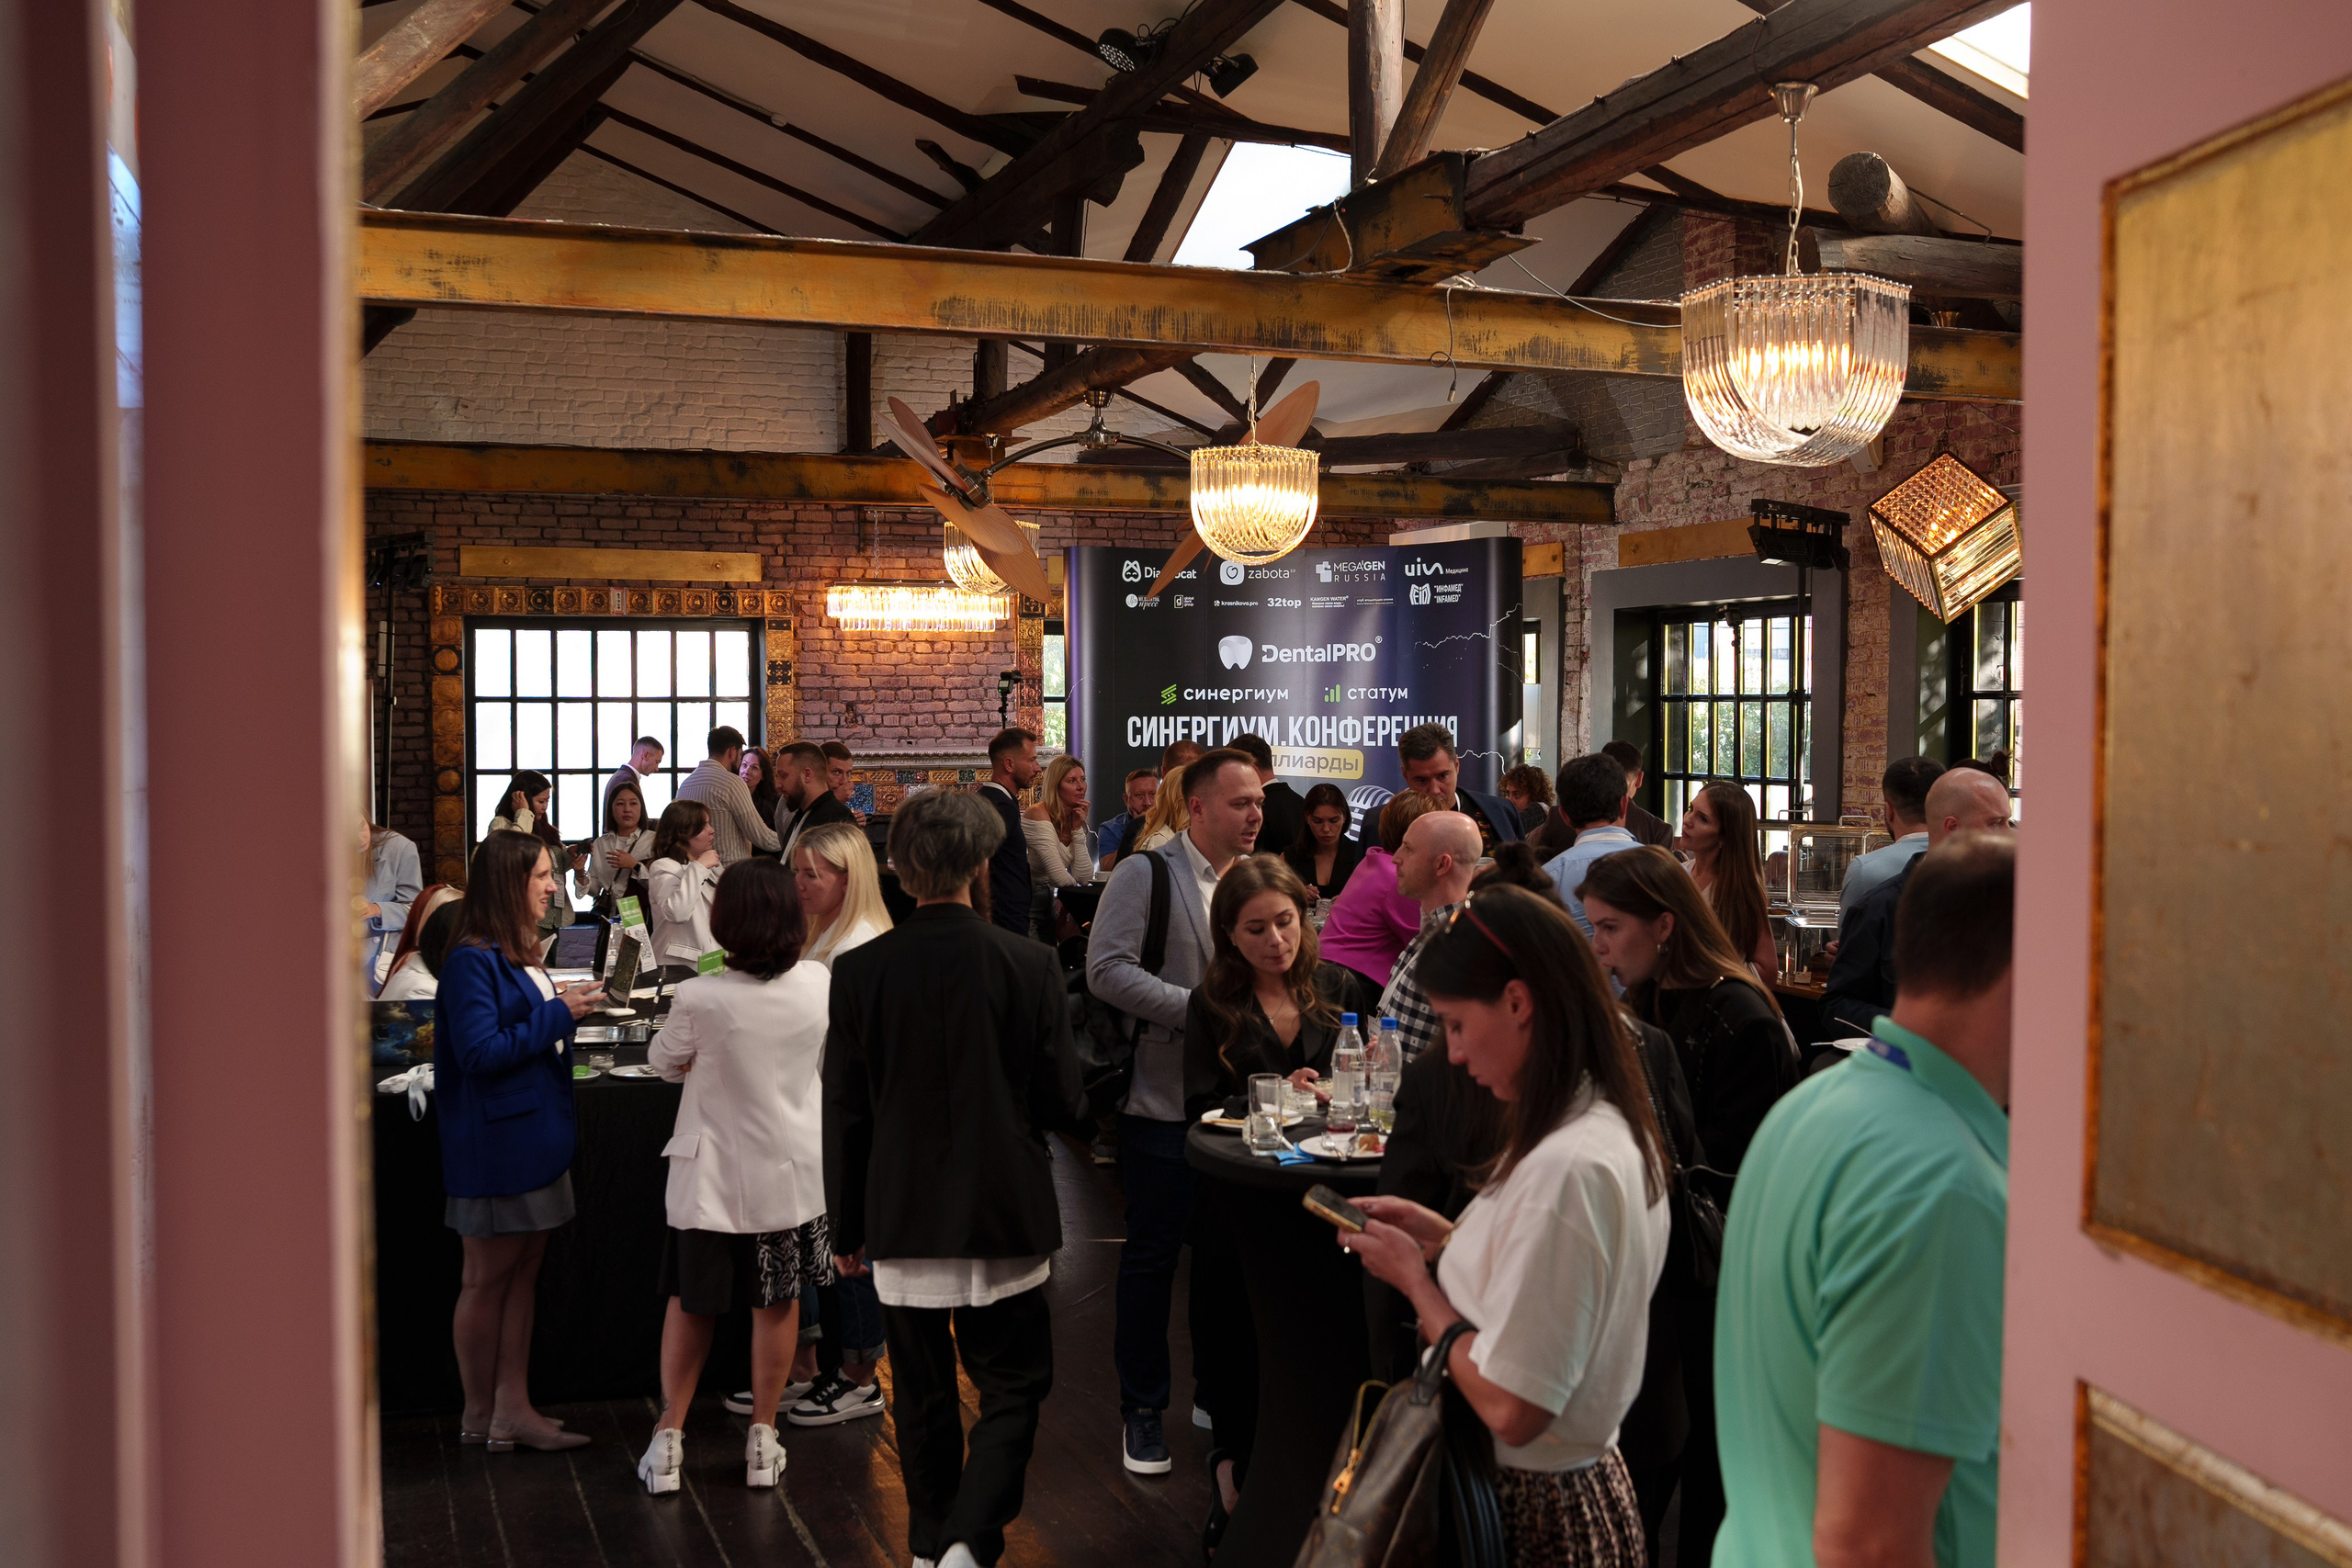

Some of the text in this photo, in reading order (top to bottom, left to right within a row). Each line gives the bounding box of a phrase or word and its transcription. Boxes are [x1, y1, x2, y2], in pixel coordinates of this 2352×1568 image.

[1248, 567, 1290, 579] zabota
[1334, 573, 1385, 582] RUSSIA
[1267, 597, 1302, 609] 32top
[1183, 688, 1289, 704] синергиум
[1347, 687, 1408, 703] статум
